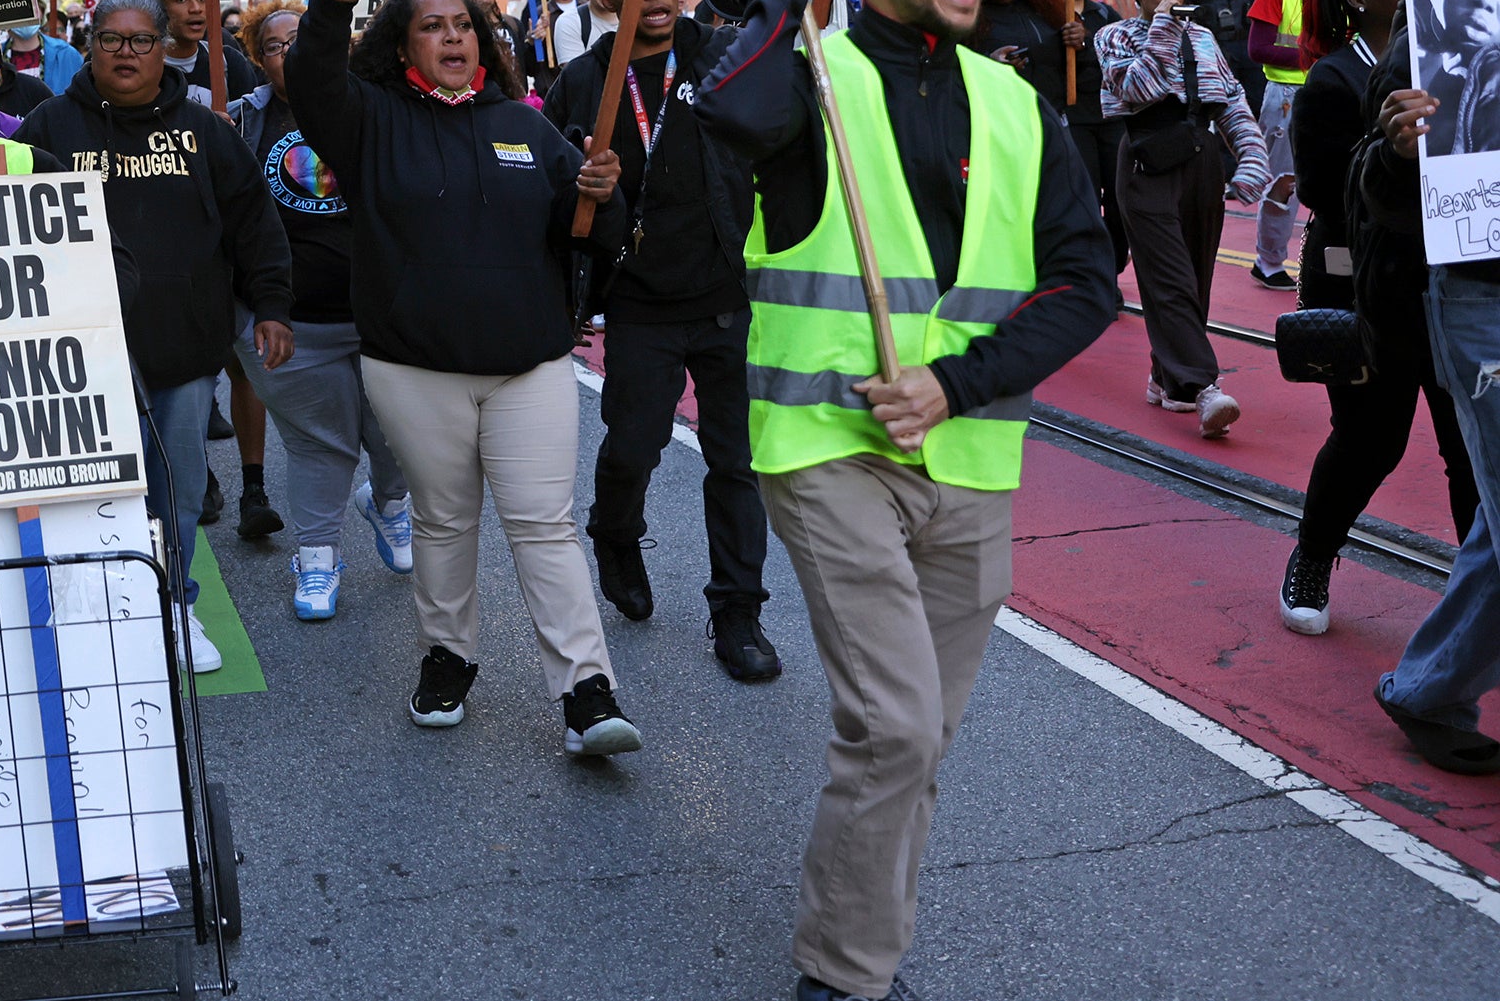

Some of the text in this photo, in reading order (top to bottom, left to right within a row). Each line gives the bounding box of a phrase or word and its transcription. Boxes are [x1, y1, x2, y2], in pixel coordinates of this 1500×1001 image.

[494, 143, 528, 153] LARKIN
[497, 151, 531, 161] STREET
[267, 175, 285, 197] LOVE
[293, 201, 316, 211] LOVE
[19, 465, 67, 488] BANKO
[69, 460, 120, 483] BROWN
[131, 697, 161, 749] for
